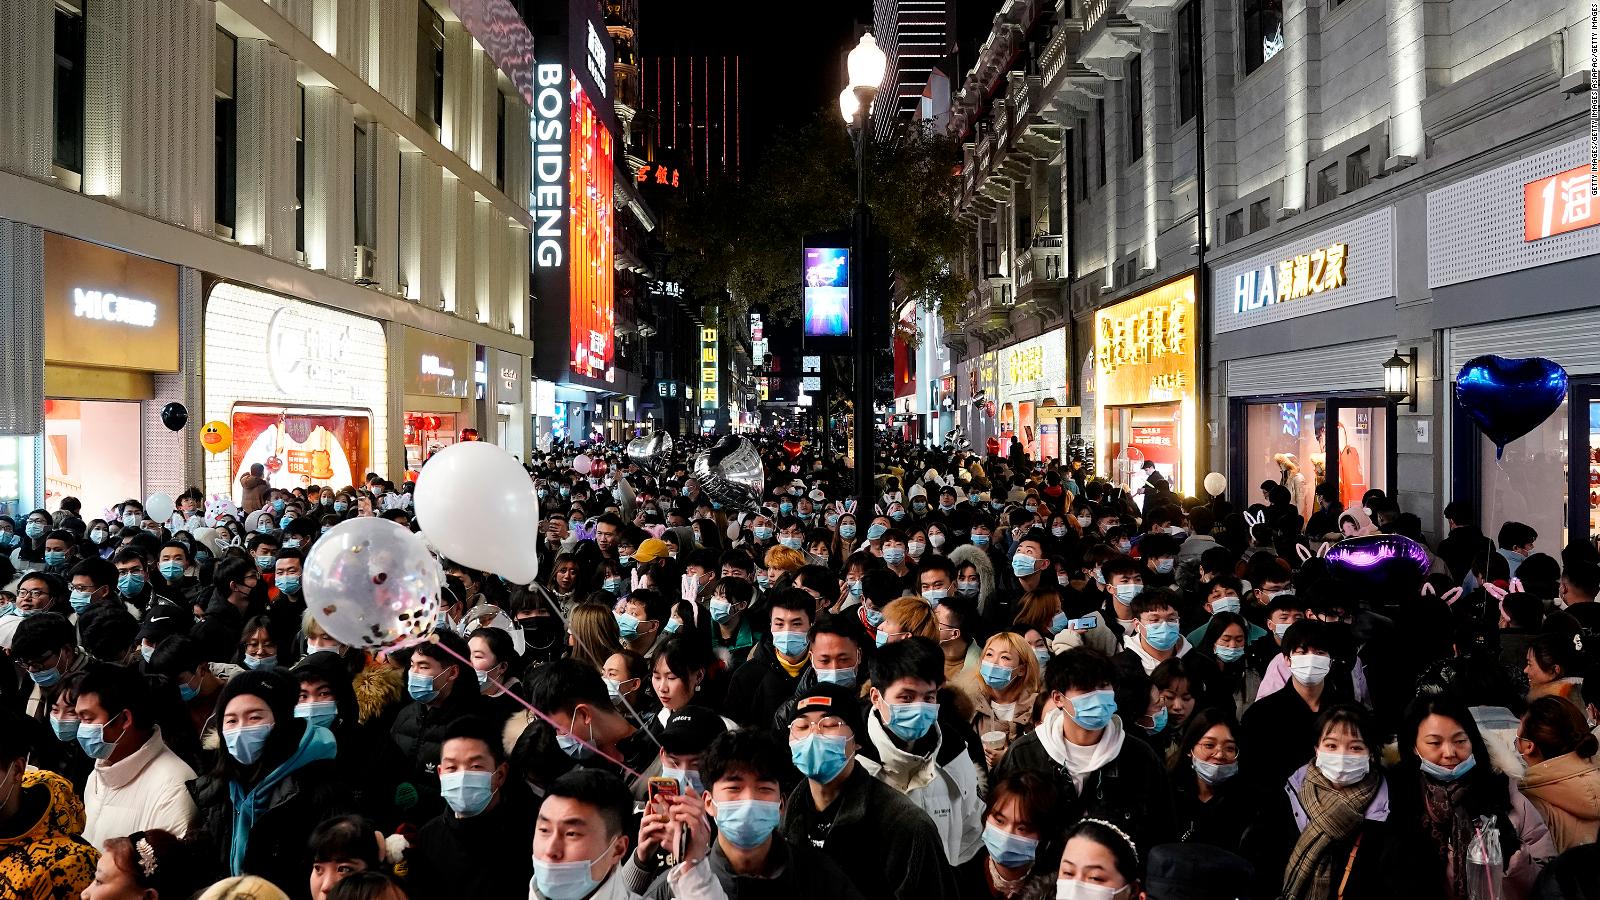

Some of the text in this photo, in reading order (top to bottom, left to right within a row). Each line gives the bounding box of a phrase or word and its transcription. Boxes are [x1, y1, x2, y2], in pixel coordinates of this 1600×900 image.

[537, 63, 563, 267] BOSIDENG
[1234, 243, 1350, 314] HLA 海澜之家
[702, 328, 717, 402] 中心百货
